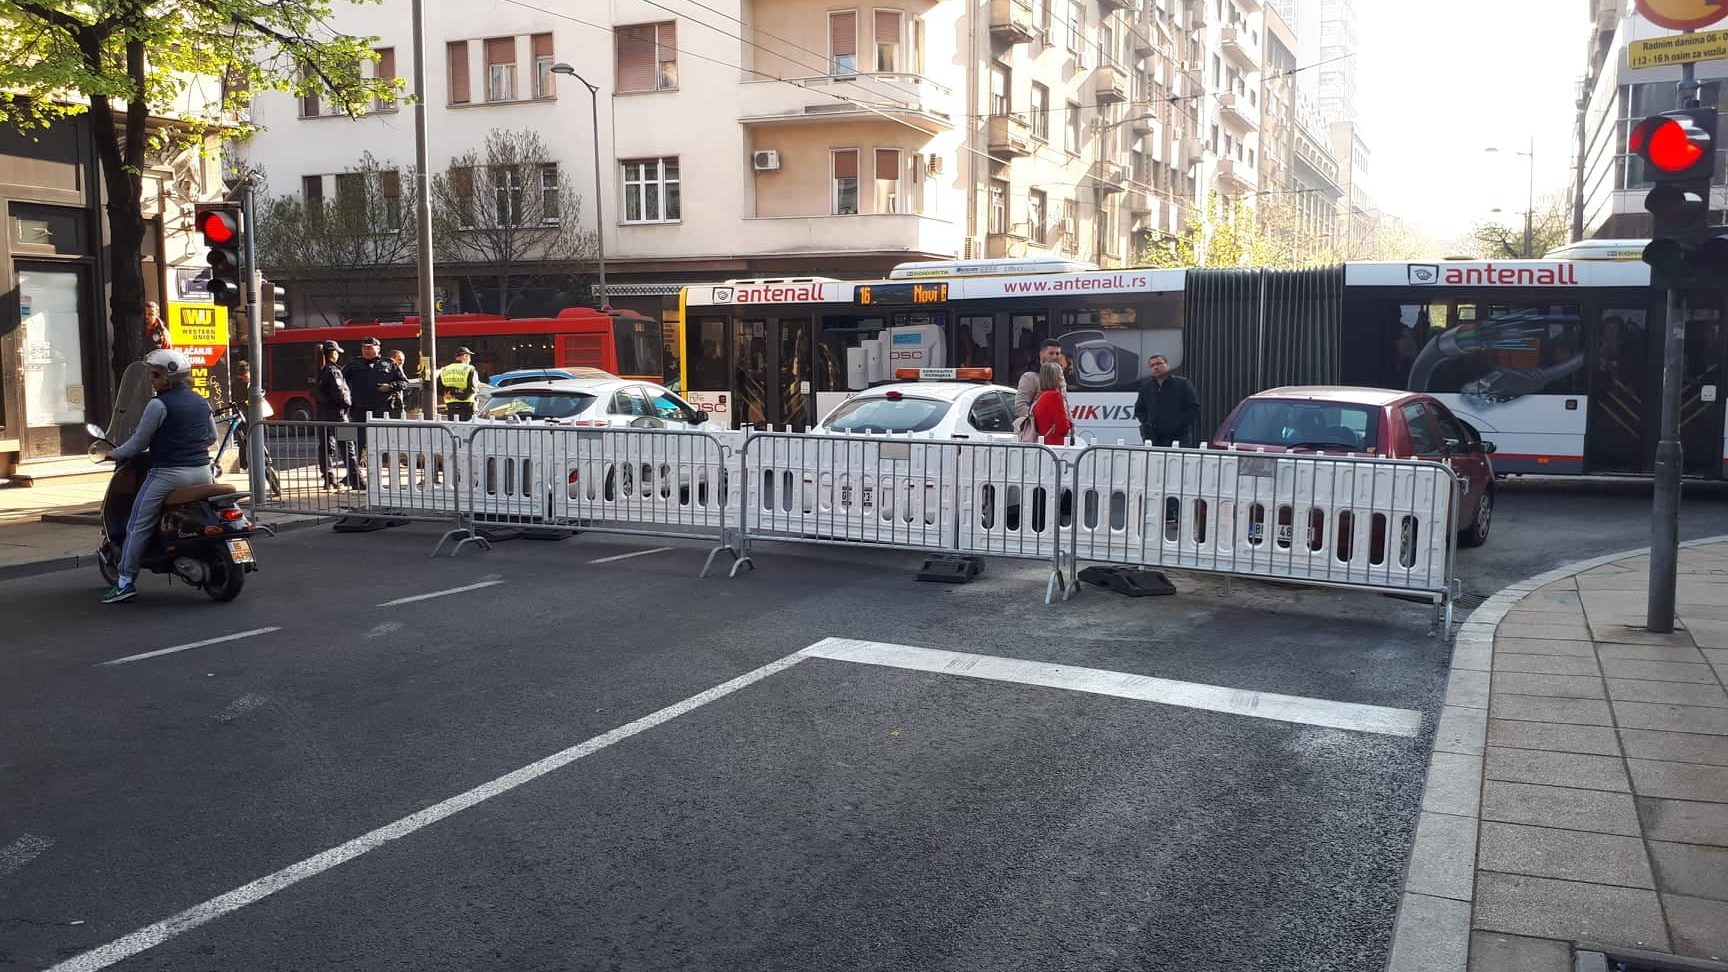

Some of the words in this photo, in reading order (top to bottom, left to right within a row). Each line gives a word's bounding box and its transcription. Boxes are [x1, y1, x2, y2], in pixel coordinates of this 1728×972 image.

[1642, 40, 1673, 51] Radnim
[1674, 36, 1705, 48] danima
[1706, 34, 1717, 43] 06
[1653, 54, 1663, 63] 16
[1664, 53, 1670, 62] h
[1671, 51, 1691, 61] osim
[1692, 51, 1702, 59] za
[1703, 46, 1727, 57] vozila
[1445, 263, 1579, 285] antenall
[736, 283, 825, 303] antenall
[914, 283, 938, 303] Novi
[1003, 275, 1147, 293] www.antenall.rs
[859, 286, 871, 305] 16
[1071, 405, 1137, 420] HIKVIS
